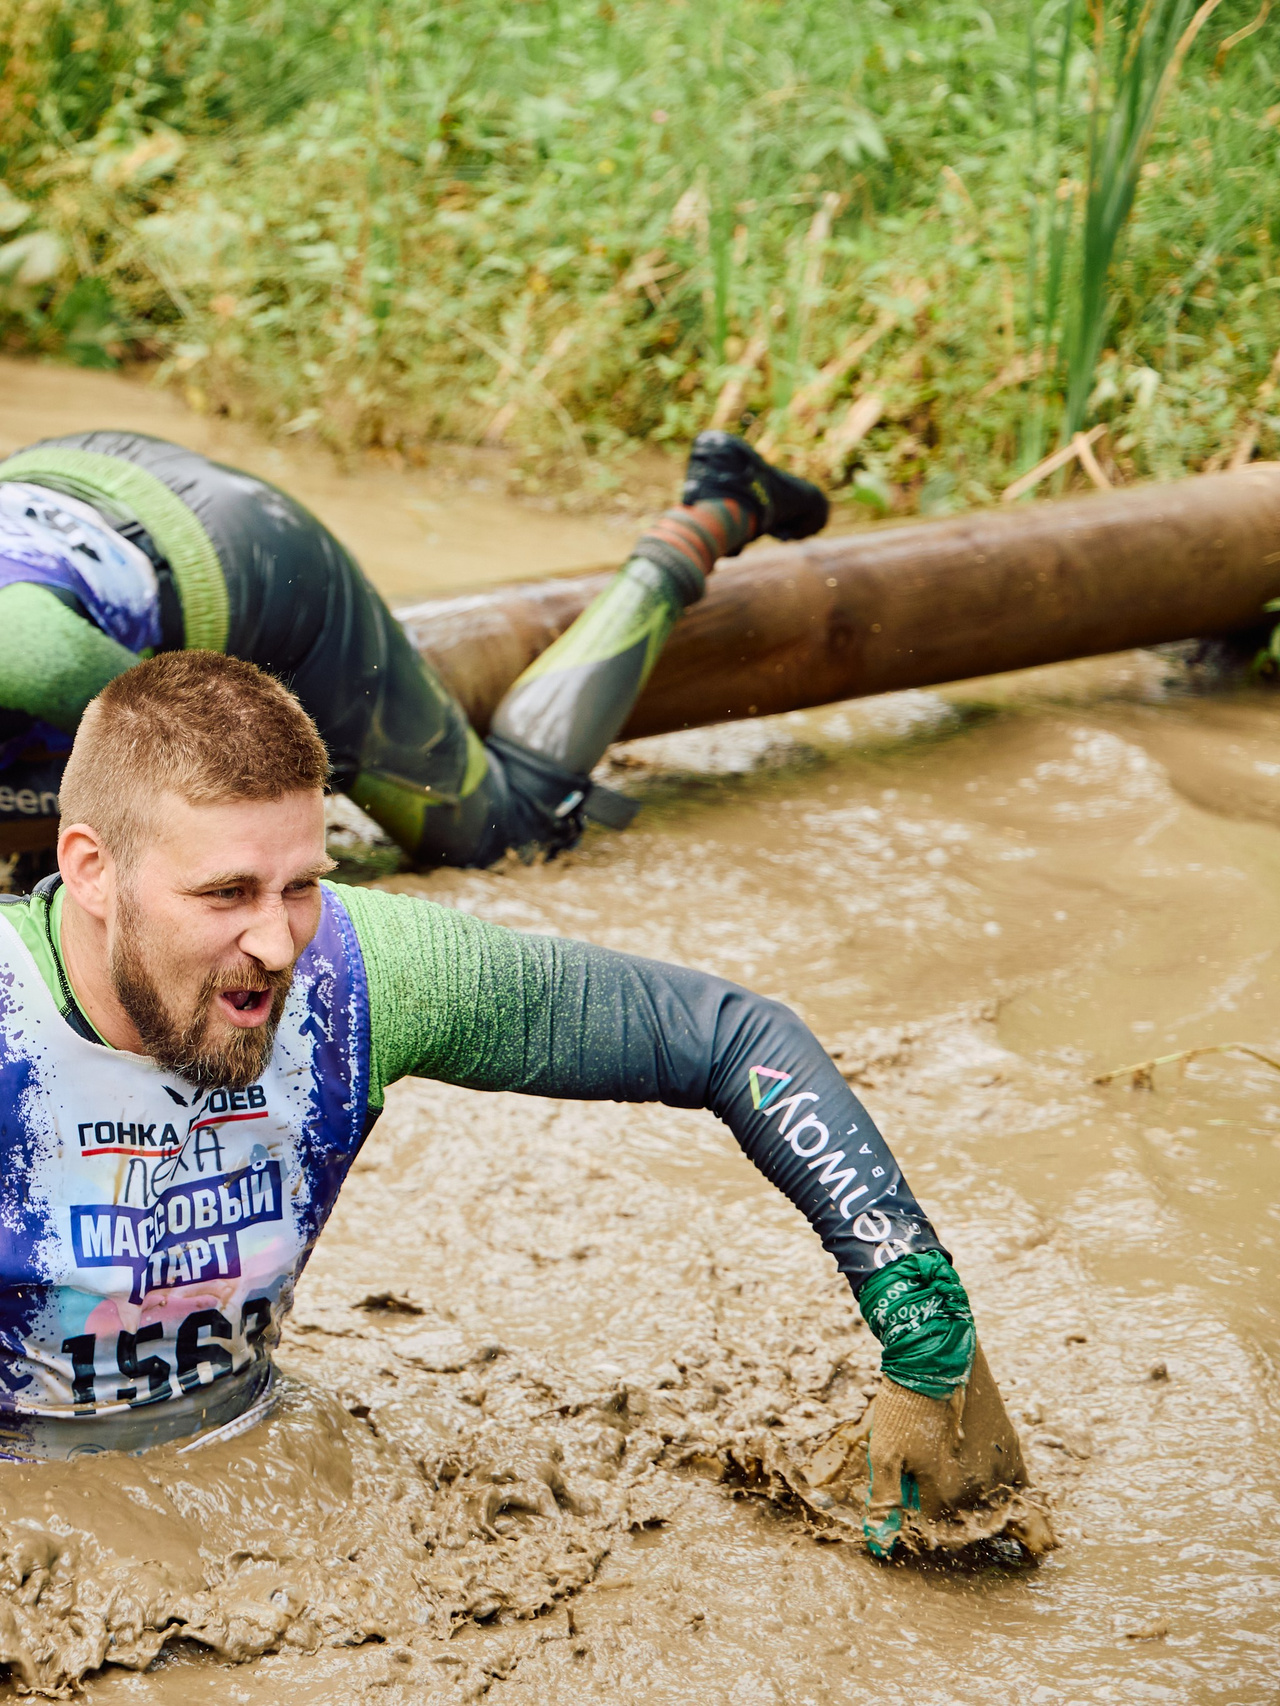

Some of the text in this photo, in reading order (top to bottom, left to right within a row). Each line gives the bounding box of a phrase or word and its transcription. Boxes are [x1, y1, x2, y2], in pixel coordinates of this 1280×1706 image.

[78, 1084, 267, 1147] ГОНКА ОЕВ
[80, 1159, 275, 1259] МАССОВЫЙ
[763, 1091, 911, 1269] eenway
[846, 1123, 922, 1236] GOBAL
